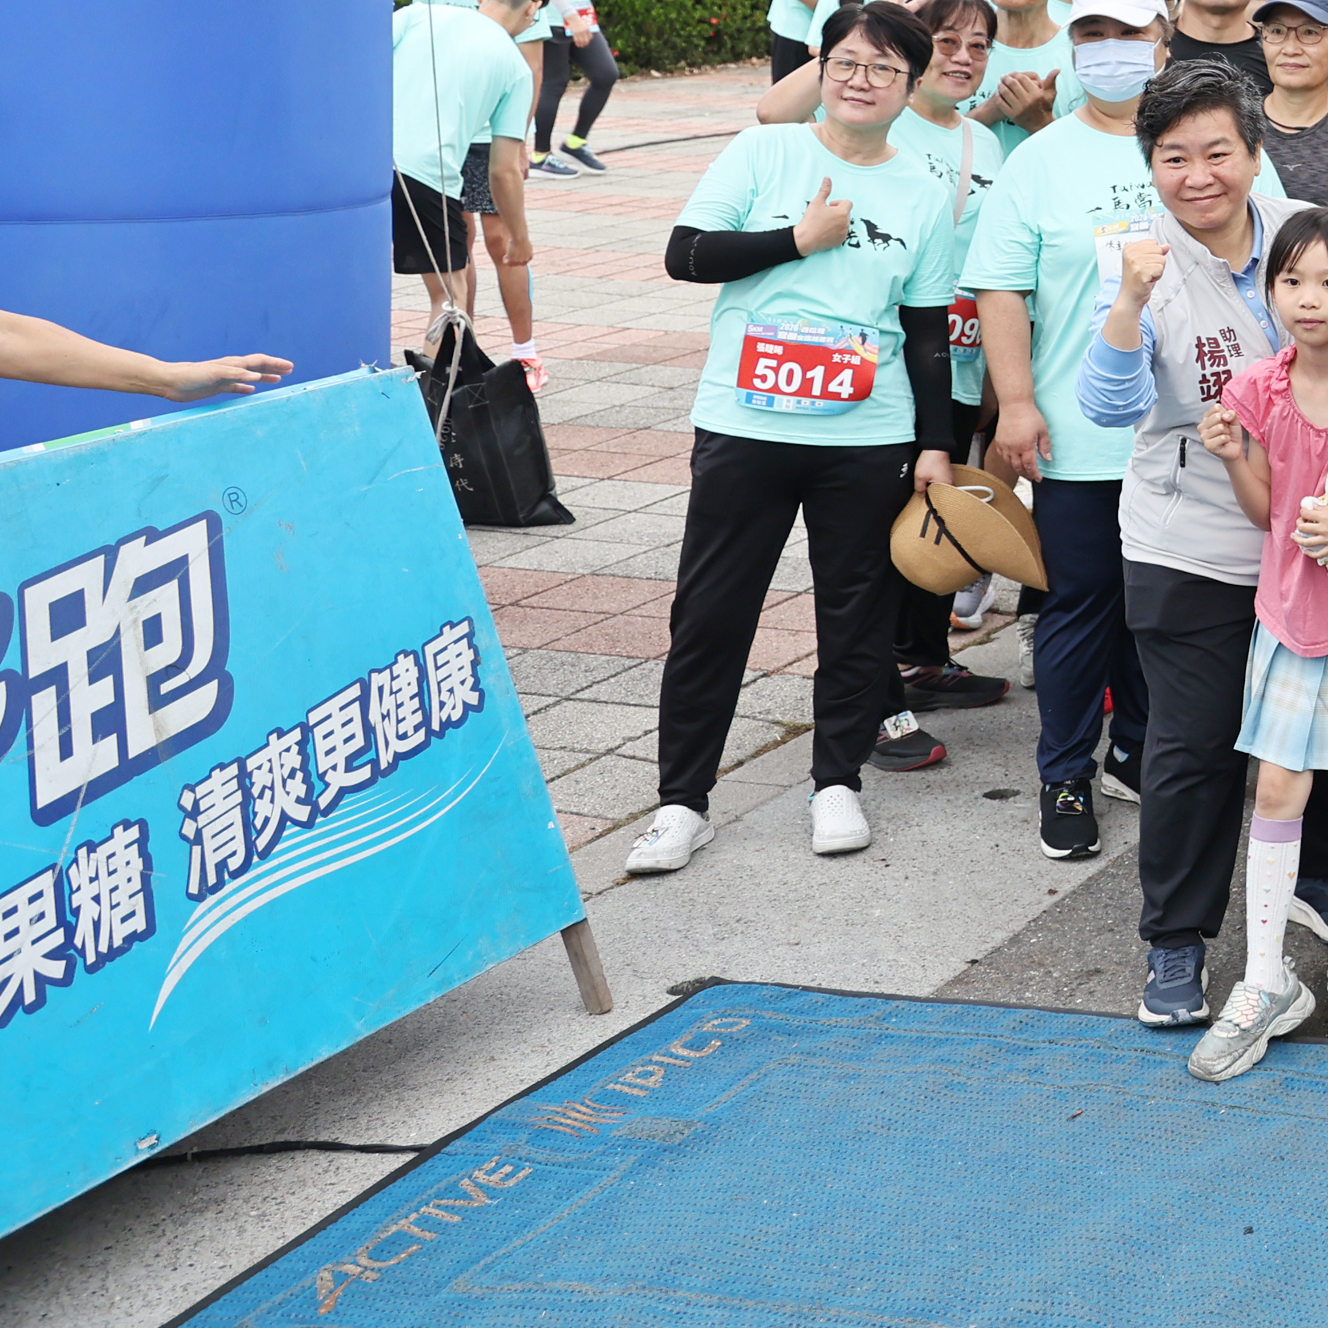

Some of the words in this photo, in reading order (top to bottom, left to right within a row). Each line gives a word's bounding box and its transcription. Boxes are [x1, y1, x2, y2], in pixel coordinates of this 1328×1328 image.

[832, 353, 862, 366] 女子組
[1219, 326, 1245, 359] 助理
[752, 356, 855, 400] 5014
[178, 620, 481, 896] 清爽更健康
[316, 1155, 533, 1316] ACTIVE
